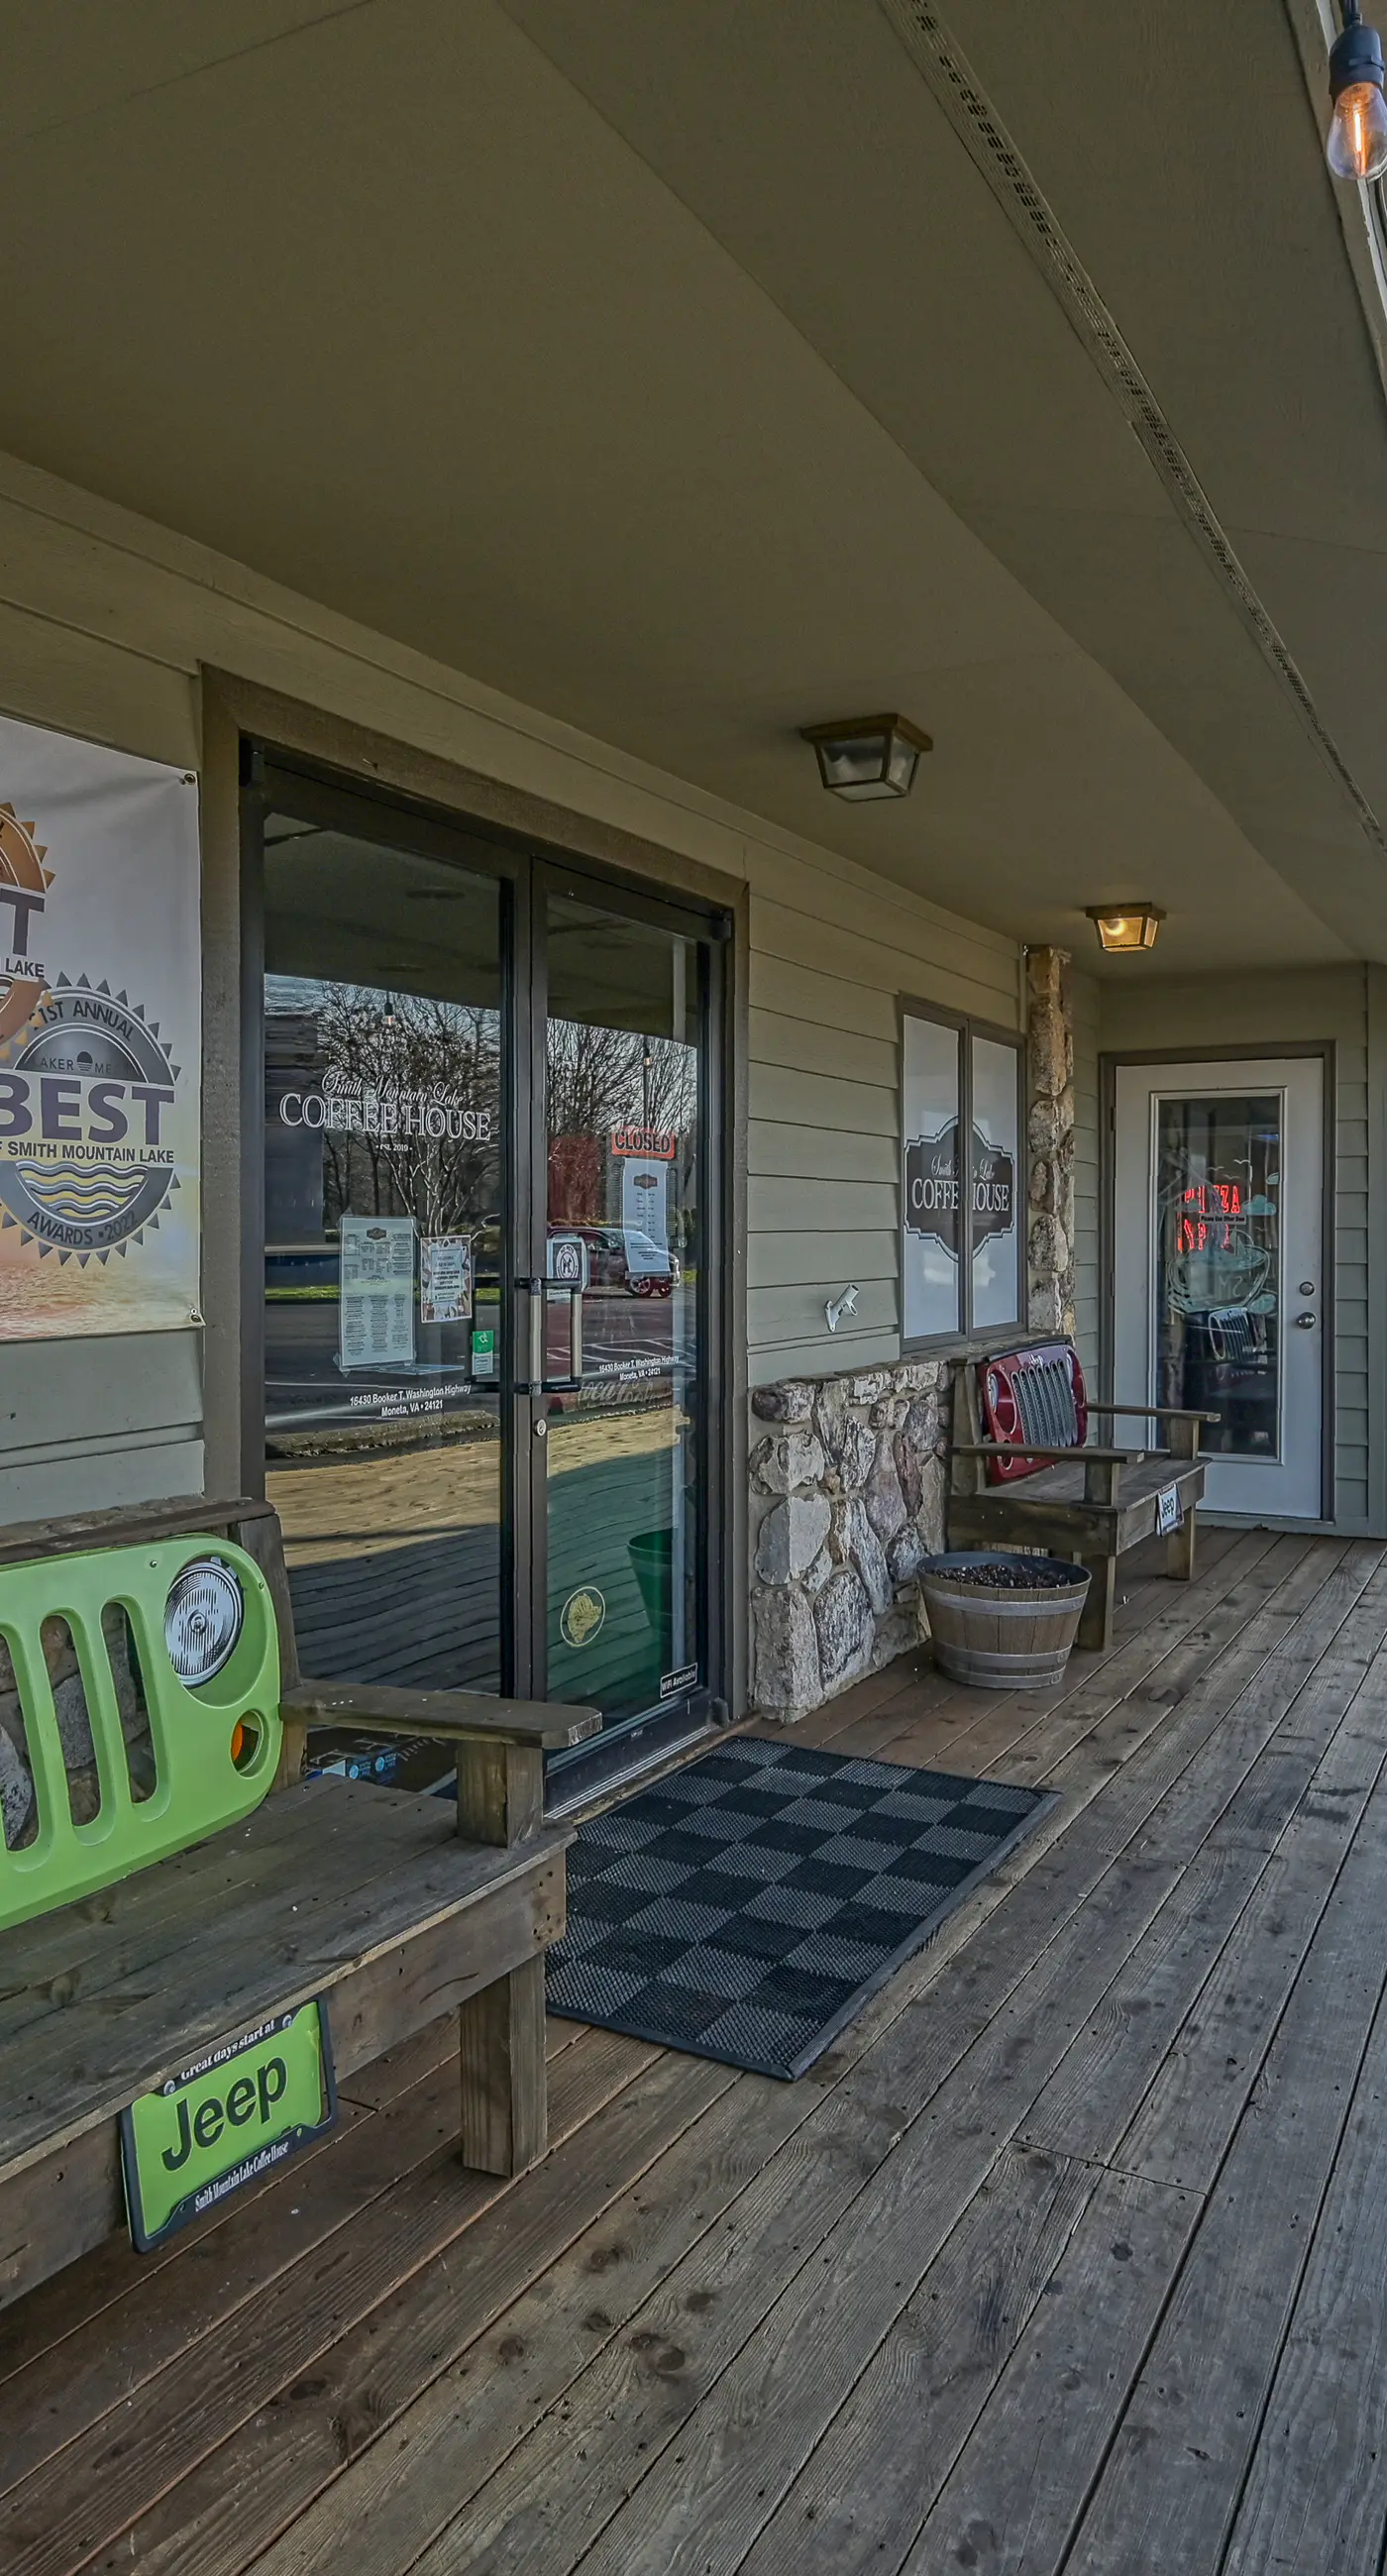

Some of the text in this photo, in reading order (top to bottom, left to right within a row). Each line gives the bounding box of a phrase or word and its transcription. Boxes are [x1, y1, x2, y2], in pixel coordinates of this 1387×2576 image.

[5, 957, 46, 978] LAKE
[72, 1001, 135, 1042] ANNUAL
[40, 1057, 74, 1070] AKER
[321, 1070, 362, 1096] Smith
[430, 1081, 464, 1107] Lake
[0, 1073, 175, 1146] BEST
[279, 1093, 490, 1141] COFFEE HOUSE
[7, 1141, 57, 1158] SMITH
[61, 1145, 136, 1162] MOUNTAIN
[139, 1148, 174, 1163] LAKE
[615, 1130, 672, 1153] CLOSED
[931, 1154, 952, 1176] Smith
[911, 1177, 959, 1210] COFFE
[27, 1210, 138, 1245] AWARDS 2022
[635, 1356, 661, 1367] Washington
[661, 1355, 680, 1364] Highway
[350, 1384, 472, 1406] 16430 Booker T. Washington Highway
[381, 1399, 444, 1417] Moneta, VA 24121
[1161, 1496, 1175, 1519] Jeep
[180, 2019, 275, 2081] Great days start at
[160, 2056, 288, 2172] Jeep
[194, 2141, 289, 2212] Smith Mountain Lake Coffee House
